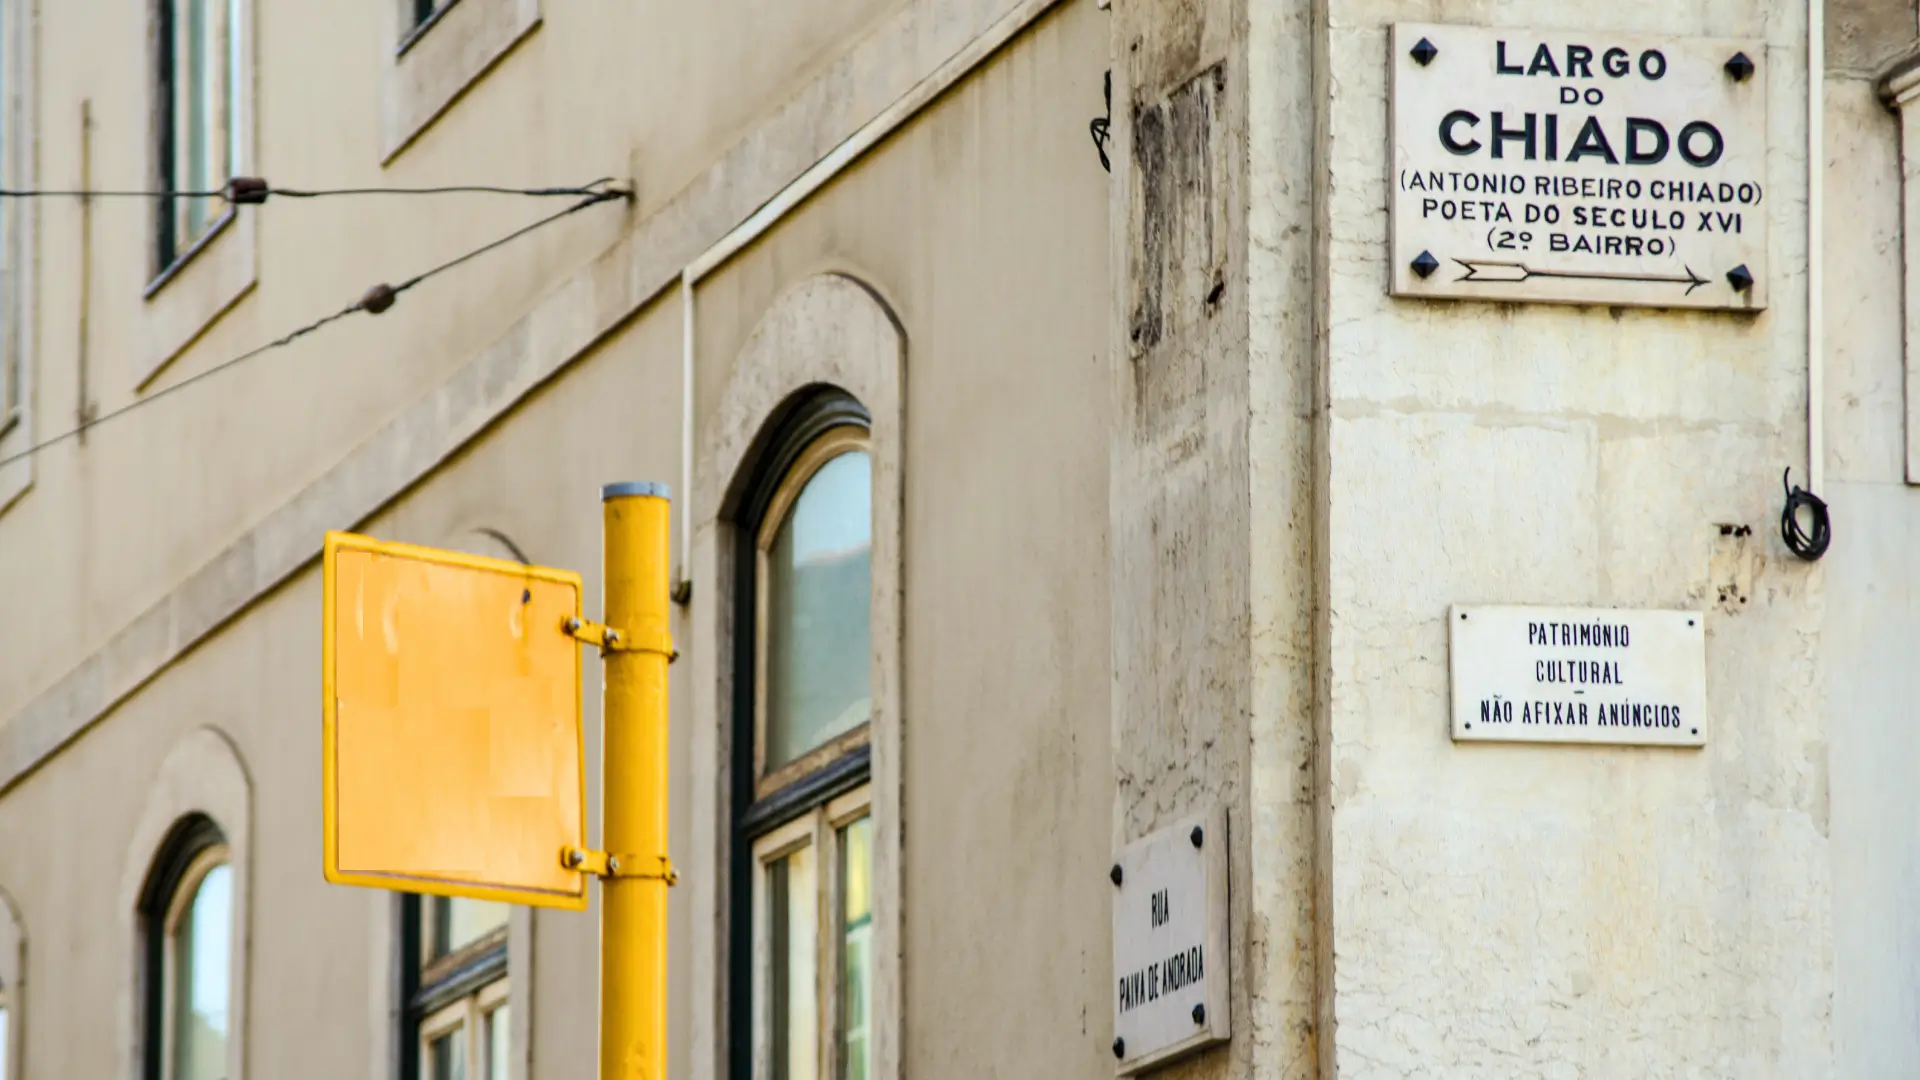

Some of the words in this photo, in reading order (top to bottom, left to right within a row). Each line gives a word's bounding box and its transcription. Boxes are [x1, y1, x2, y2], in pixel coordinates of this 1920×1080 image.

[1496, 40, 1667, 81] LARGO
[1560, 86, 1604, 105] DO
[1438, 109, 1724, 168] CHIADO
[1400, 169, 1526, 195] (ANTONIO
[1535, 176, 1641, 200] RIBEIRO
[1650, 180, 1763, 206] CHIADO)
[1422, 199, 1513, 223] POETA
[1525, 204, 1560, 225] DO
[1573, 206, 1685, 231] SECULO
[1697, 211, 1742, 234] XVI
[1549, 233, 1676, 257] BAIRRO)
[1528, 617, 1630, 648] PATRIMÓNIO
[1536, 660, 1623, 685] CULTURAL
[1480, 694, 1513, 724] NÃO
[1522, 700, 1588, 726] AFIXAR
[1597, 697, 1681, 728] ANÚNCIOS
[1151, 888, 1169, 929] RUA
[1119, 969, 1145, 1013] PAIVA
[1148, 962, 1159, 1002] DE
[1162, 944, 1204, 996] ANDRADA
